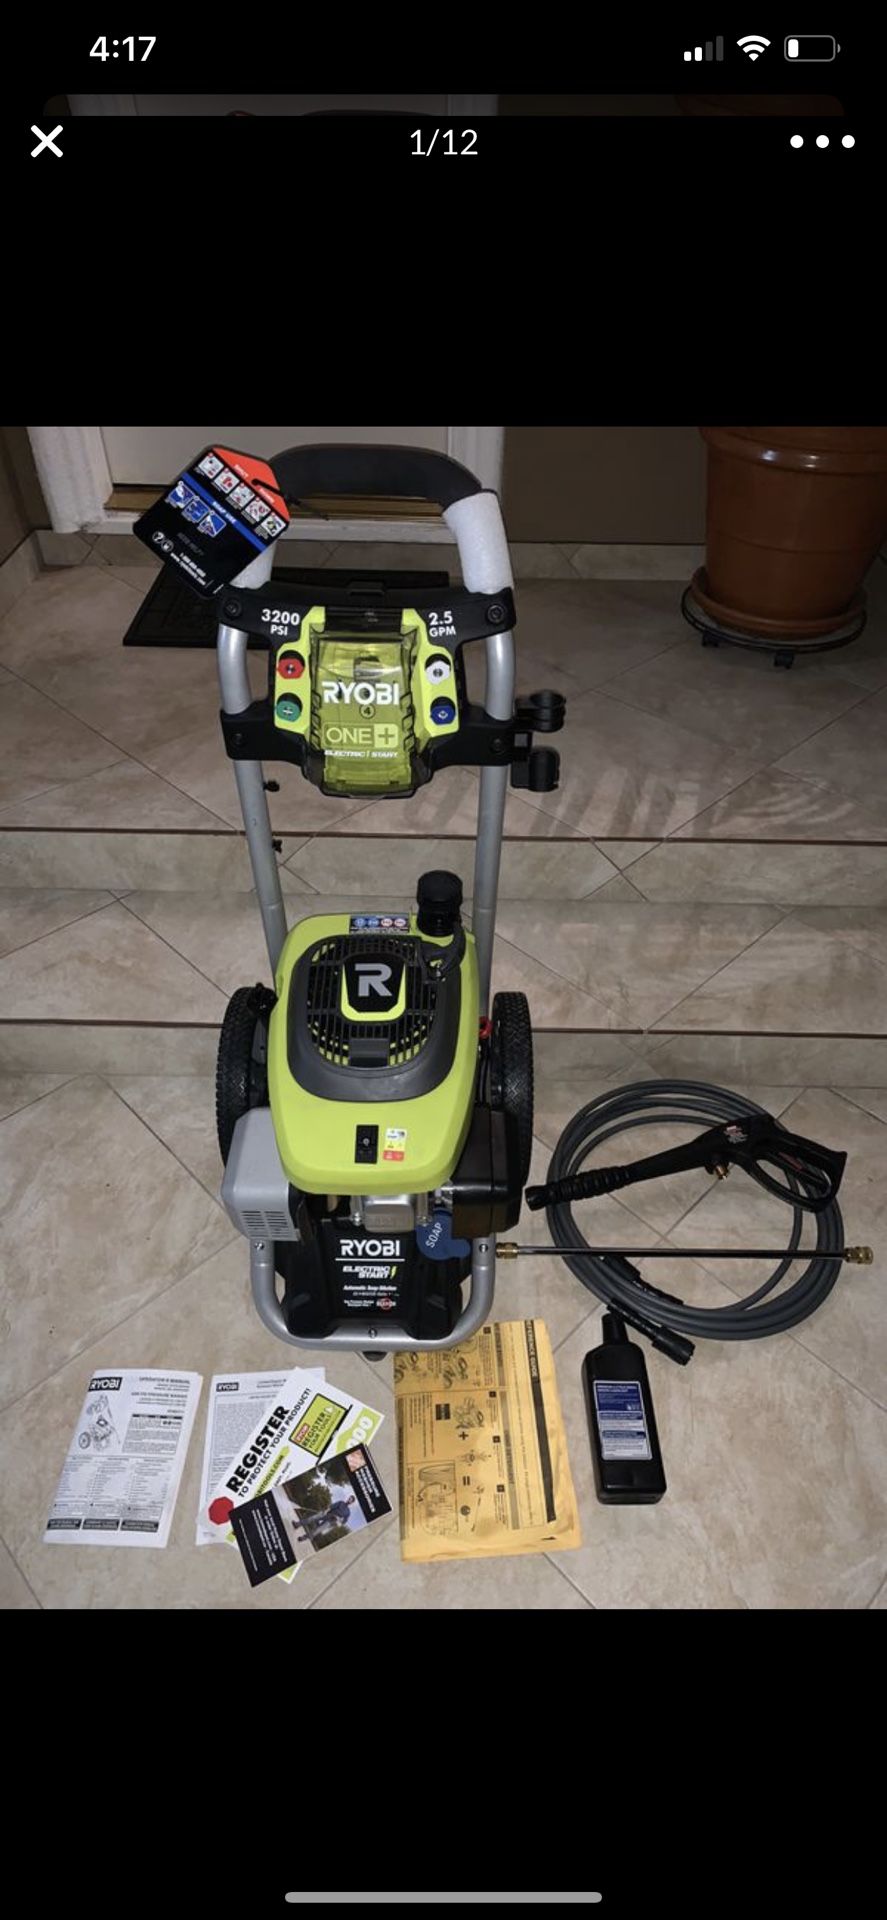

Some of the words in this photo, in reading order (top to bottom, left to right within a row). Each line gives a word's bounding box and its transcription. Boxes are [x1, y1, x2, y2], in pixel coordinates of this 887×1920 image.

[261, 609, 300, 626] 3200
[428, 611, 454, 626] 2.5
[270, 625, 288, 636] PSI
[429, 627, 456, 638] GPM
[321, 681, 399, 705] RYOBI
[355, 963, 392, 996] R
[425, 1222, 444, 1248] SOAP
[340, 1239, 400, 1256] RYOBI
[342, 1265, 391, 1273] ELECTRIC
[358, 1271, 389, 1279] START
[89, 1379, 119, 1390] RYOBI
[225, 1405, 290, 1494] REGISTER
[238, 1486, 250, 1498] TO
[248, 1449, 272, 1486] PROTECT
[269, 1425, 287, 1449] YOUR
[285, 1387, 312, 1426] PRODUCT!
